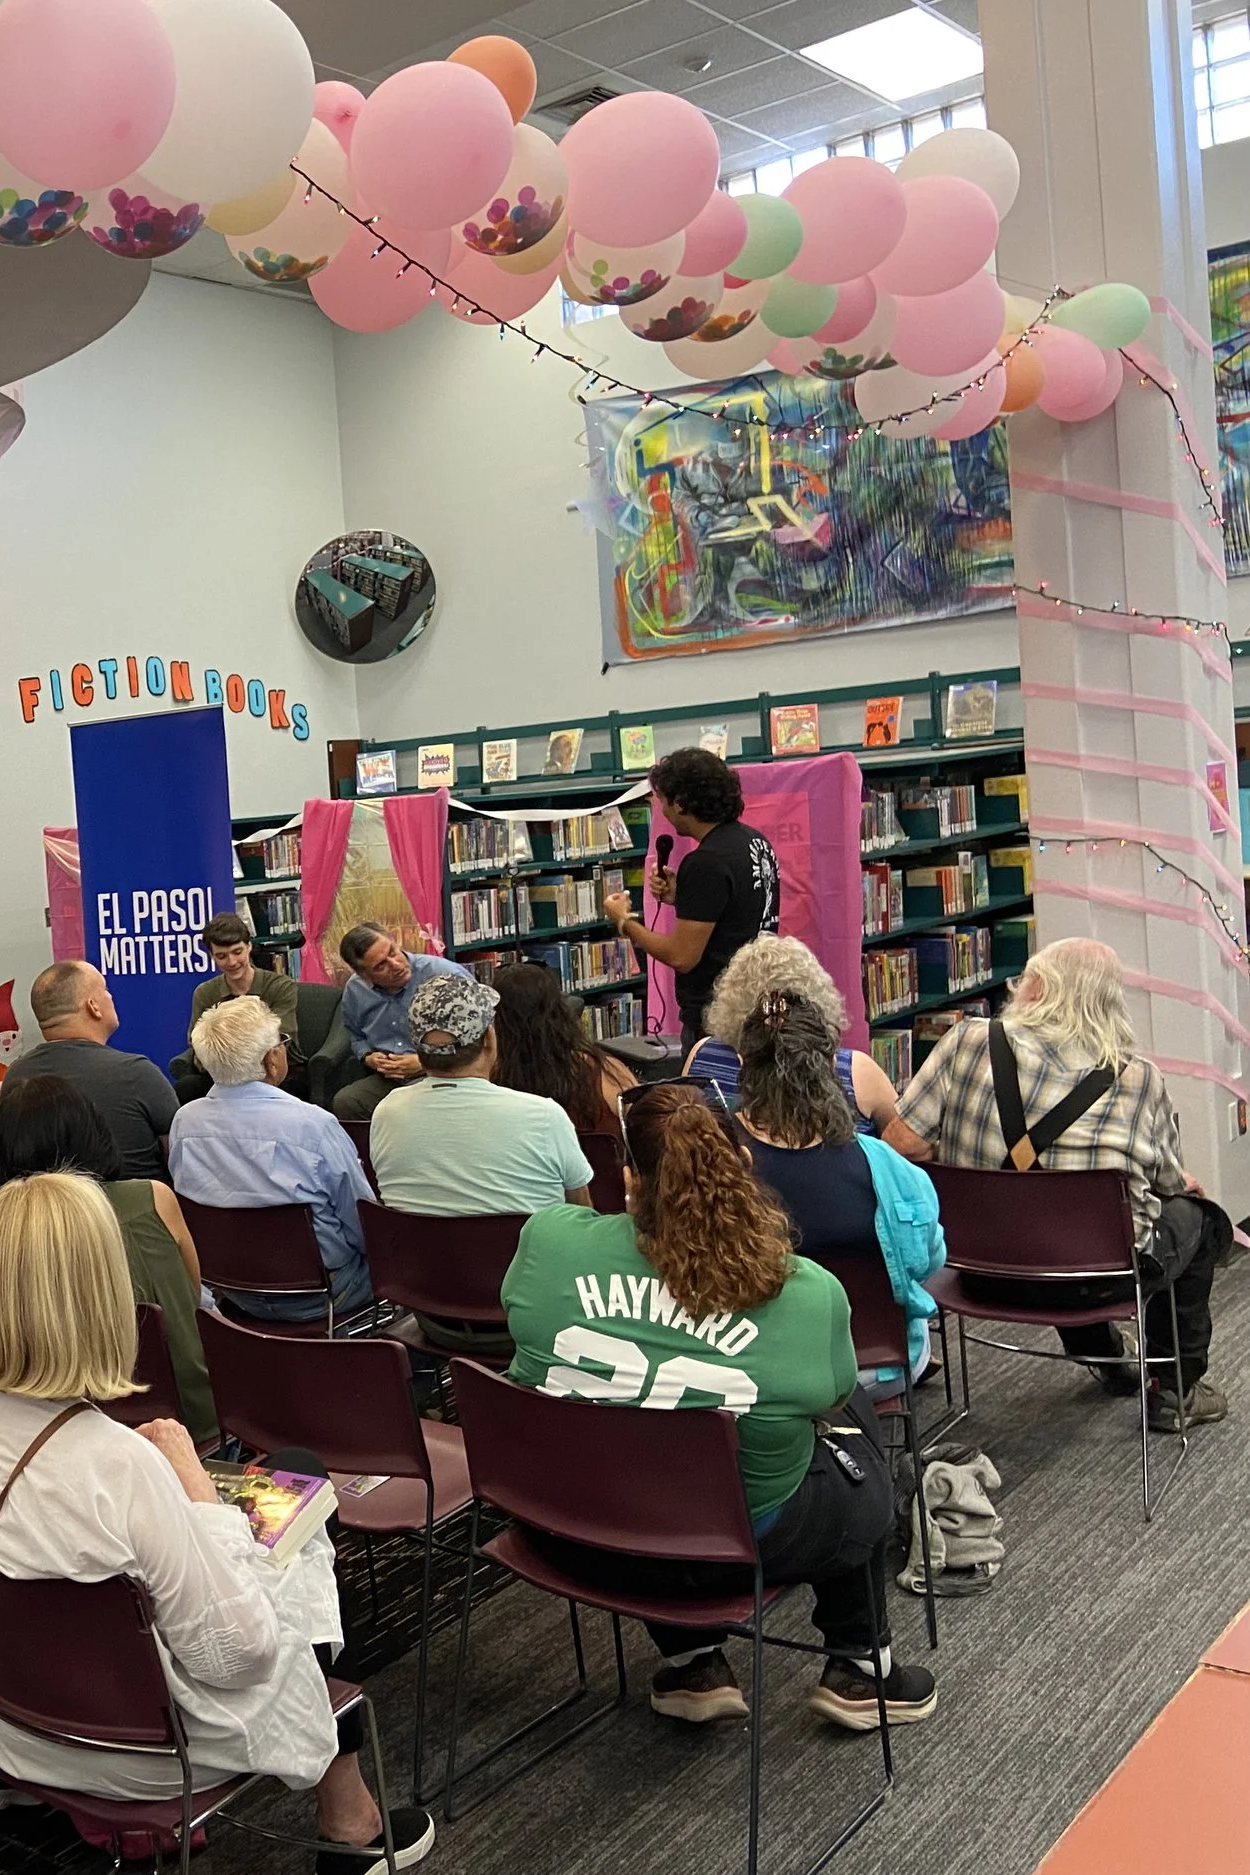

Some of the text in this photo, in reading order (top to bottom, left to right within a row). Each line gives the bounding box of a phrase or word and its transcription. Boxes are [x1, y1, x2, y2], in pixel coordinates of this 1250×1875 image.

[18, 656, 194, 723] FICTION
[205, 669, 310, 741] BOOKS
[97, 887, 206, 935] EL PASO
[100, 934, 209, 976] MATTERS
[575, 1274, 759, 1357] HAYWARD
